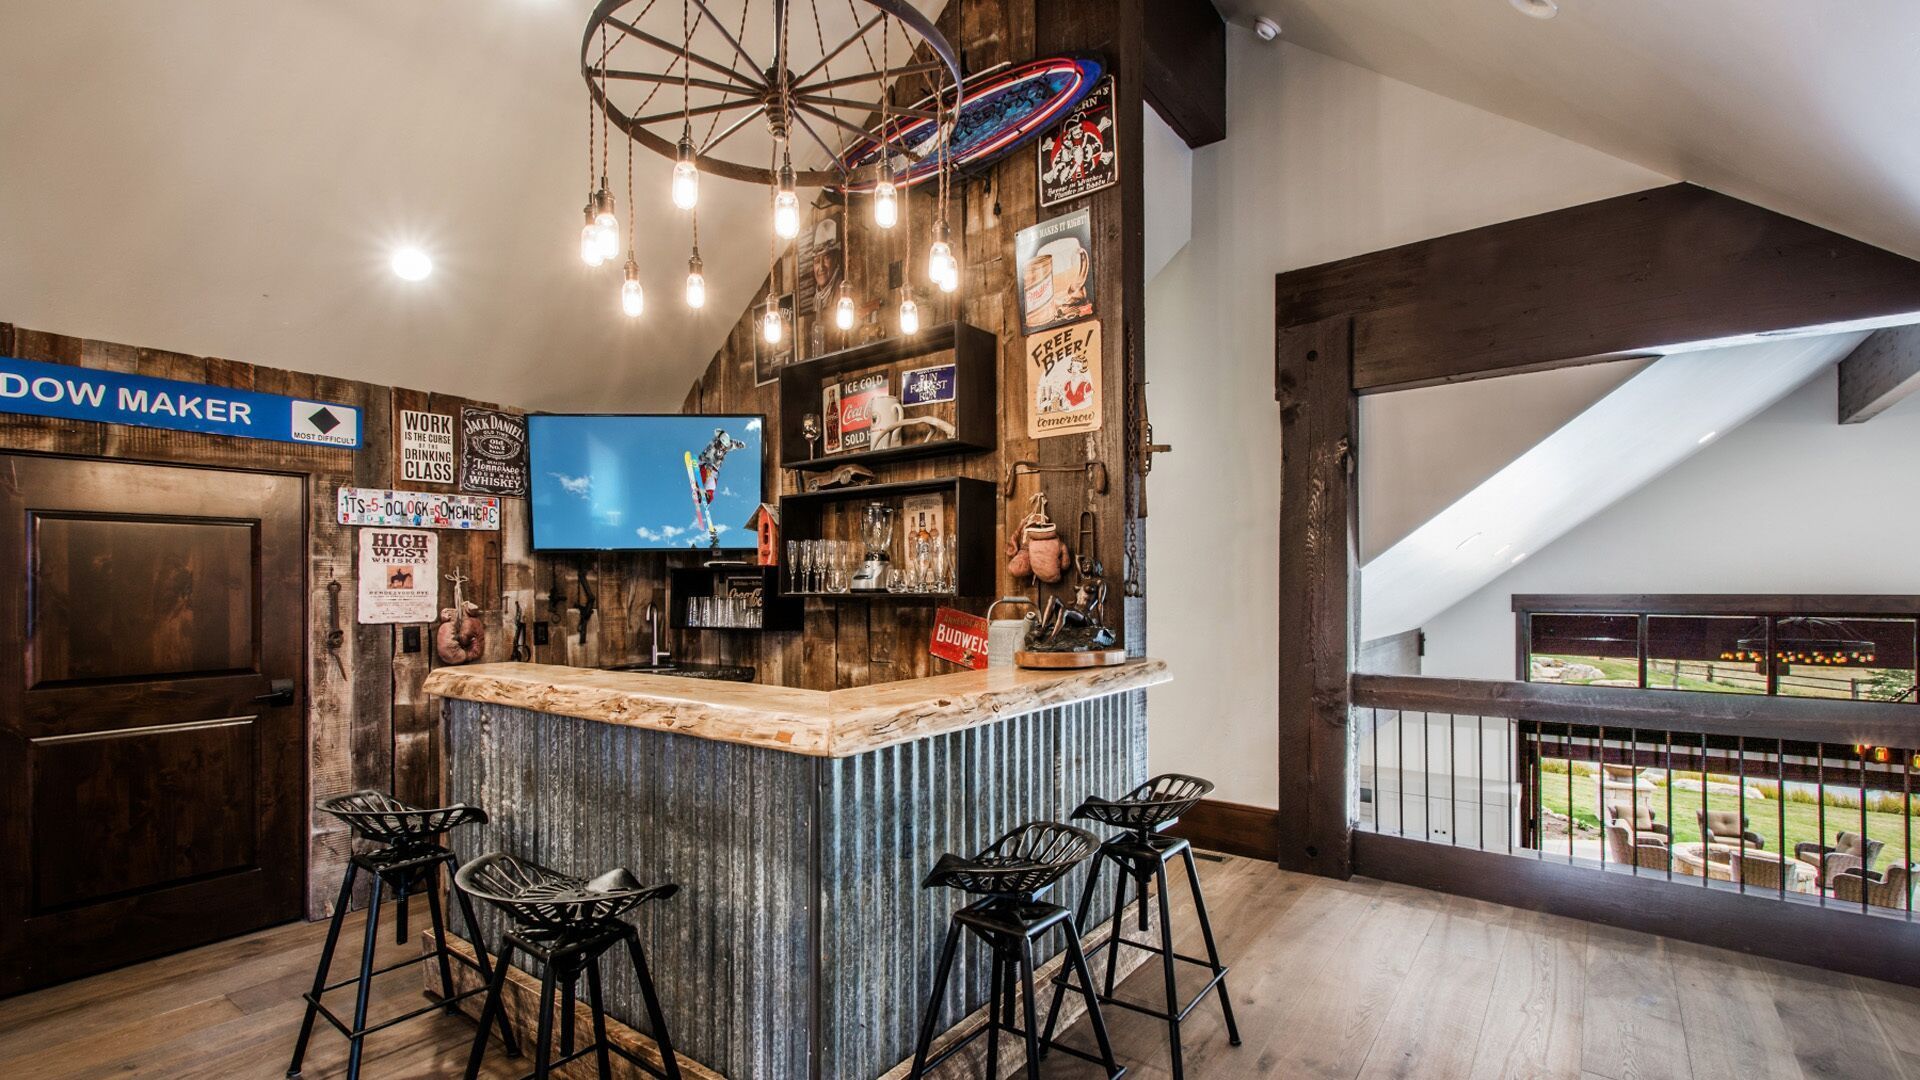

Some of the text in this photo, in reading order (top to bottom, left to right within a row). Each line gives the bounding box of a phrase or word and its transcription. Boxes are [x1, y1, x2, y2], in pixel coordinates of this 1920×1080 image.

[1031, 327, 1074, 368] FREE
[1041, 329, 1095, 377] BEER!
[844, 374, 884, 395] ICE COLD
[0, 372, 252, 425] DOW MAKER
[404, 411, 451, 435] WORK
[465, 418, 490, 435] JACK
[293, 431, 356, 445] MOST DIFFICULT
[404, 431, 452, 445] IS THE CURSE
[845, 431, 866, 446] SOLD
[404, 448, 452, 464] DRINKING
[405, 460, 452, 481] CLASS
[469, 475, 521, 489] WHISKEY
[371, 532, 429, 549] HIGH
[371, 556, 429, 564] WHISKEY
[372, 547, 429, 558] WEST
[936, 623, 989, 656] BUDWEIS
